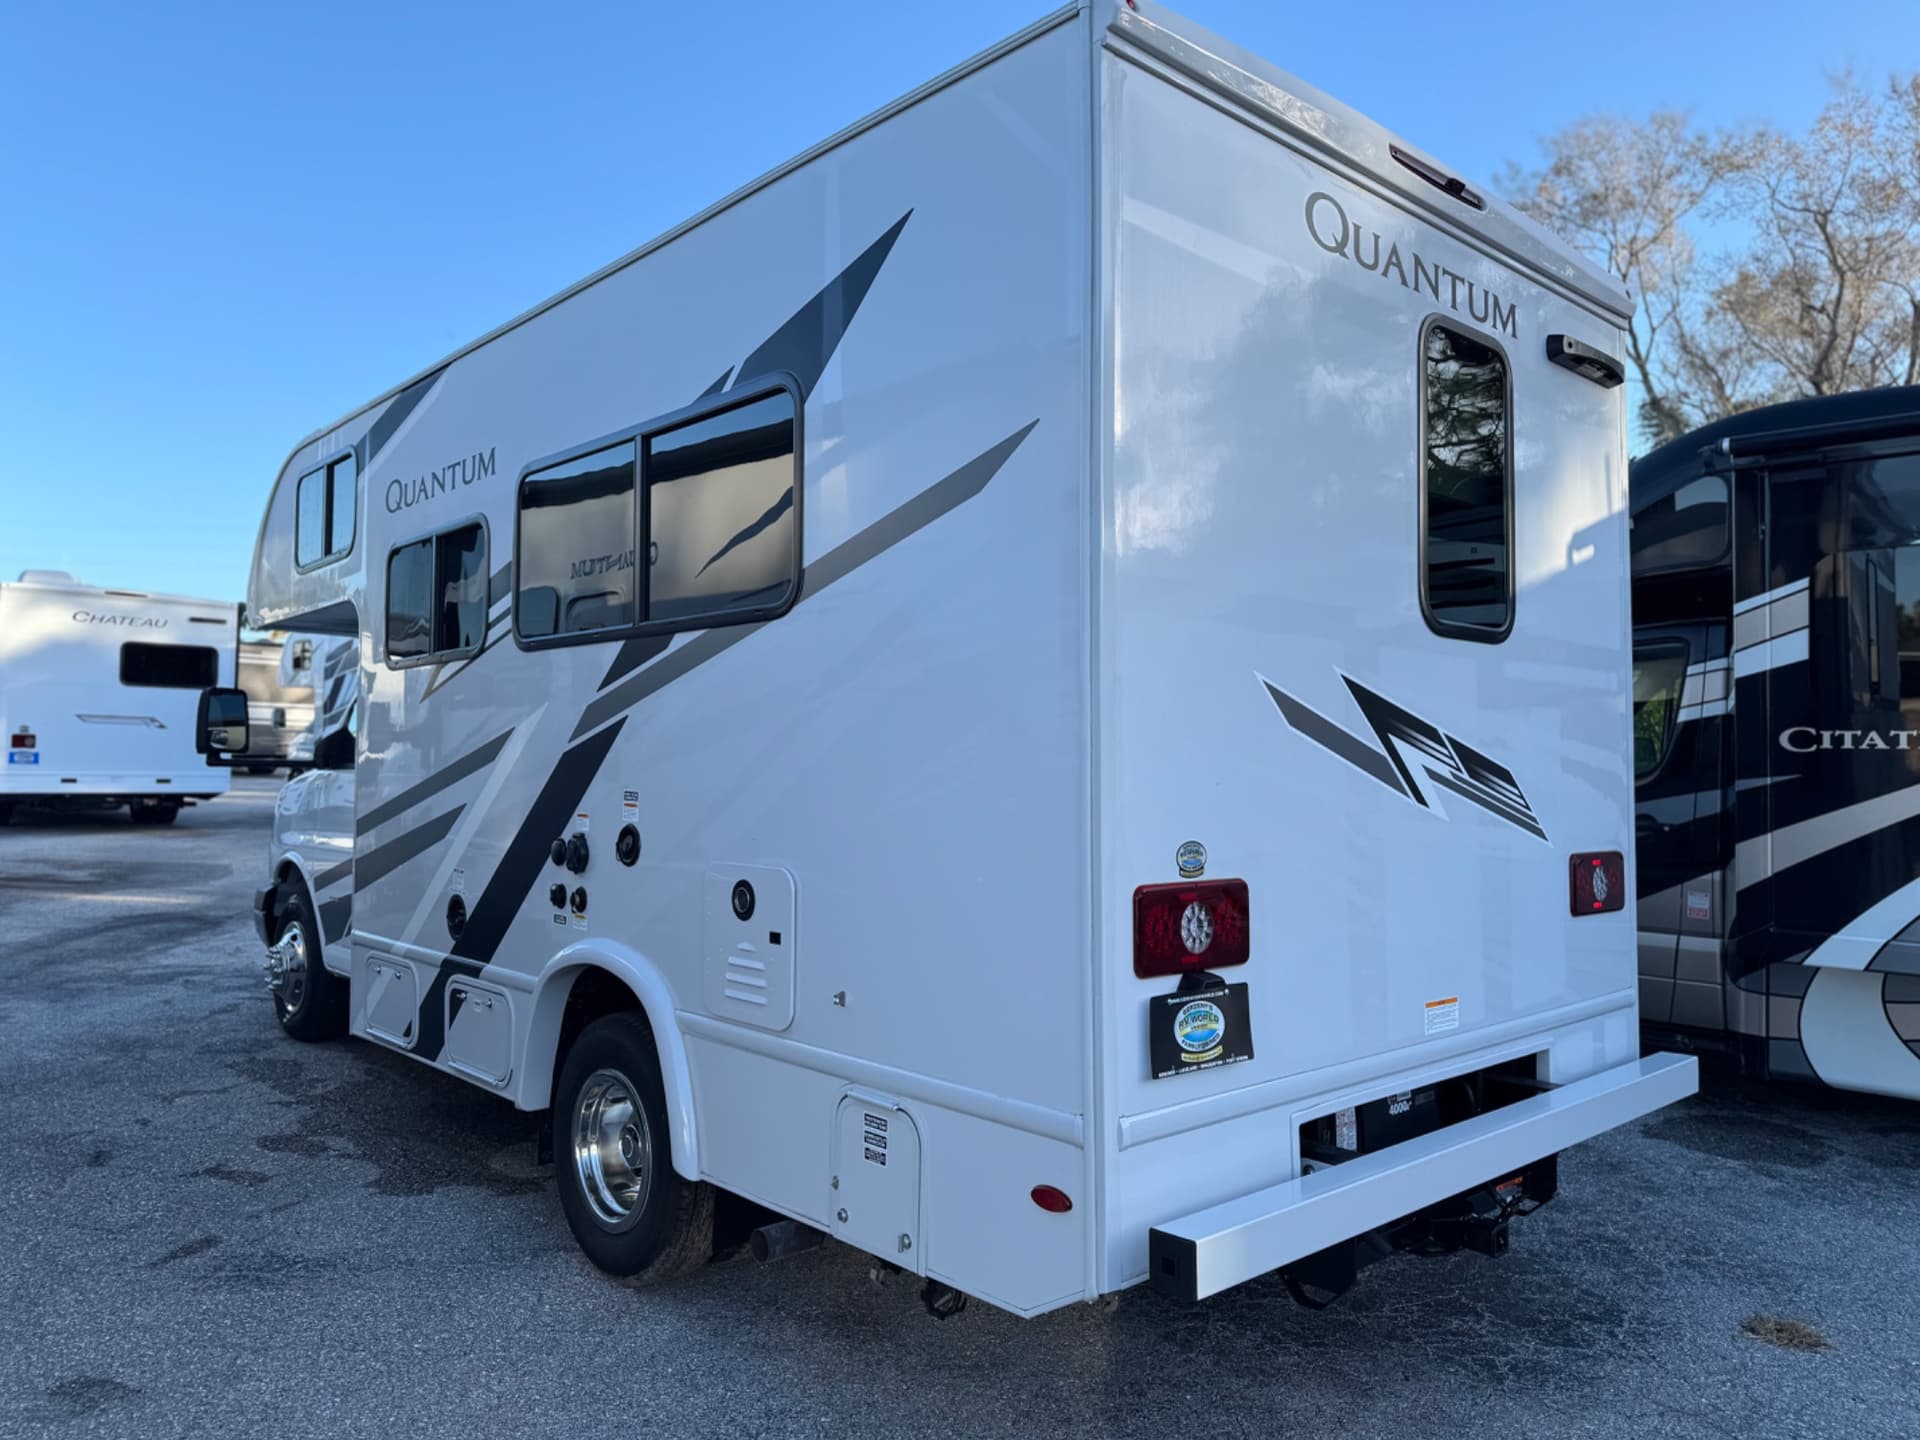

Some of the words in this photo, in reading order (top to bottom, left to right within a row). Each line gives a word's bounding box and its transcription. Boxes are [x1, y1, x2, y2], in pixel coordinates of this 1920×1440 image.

[1305, 192, 1518, 339] QUANTUM
[385, 447, 497, 513] QUANTUM
[72, 610, 169, 629] CHATEAU
[1778, 726, 1920, 753] CITAT
